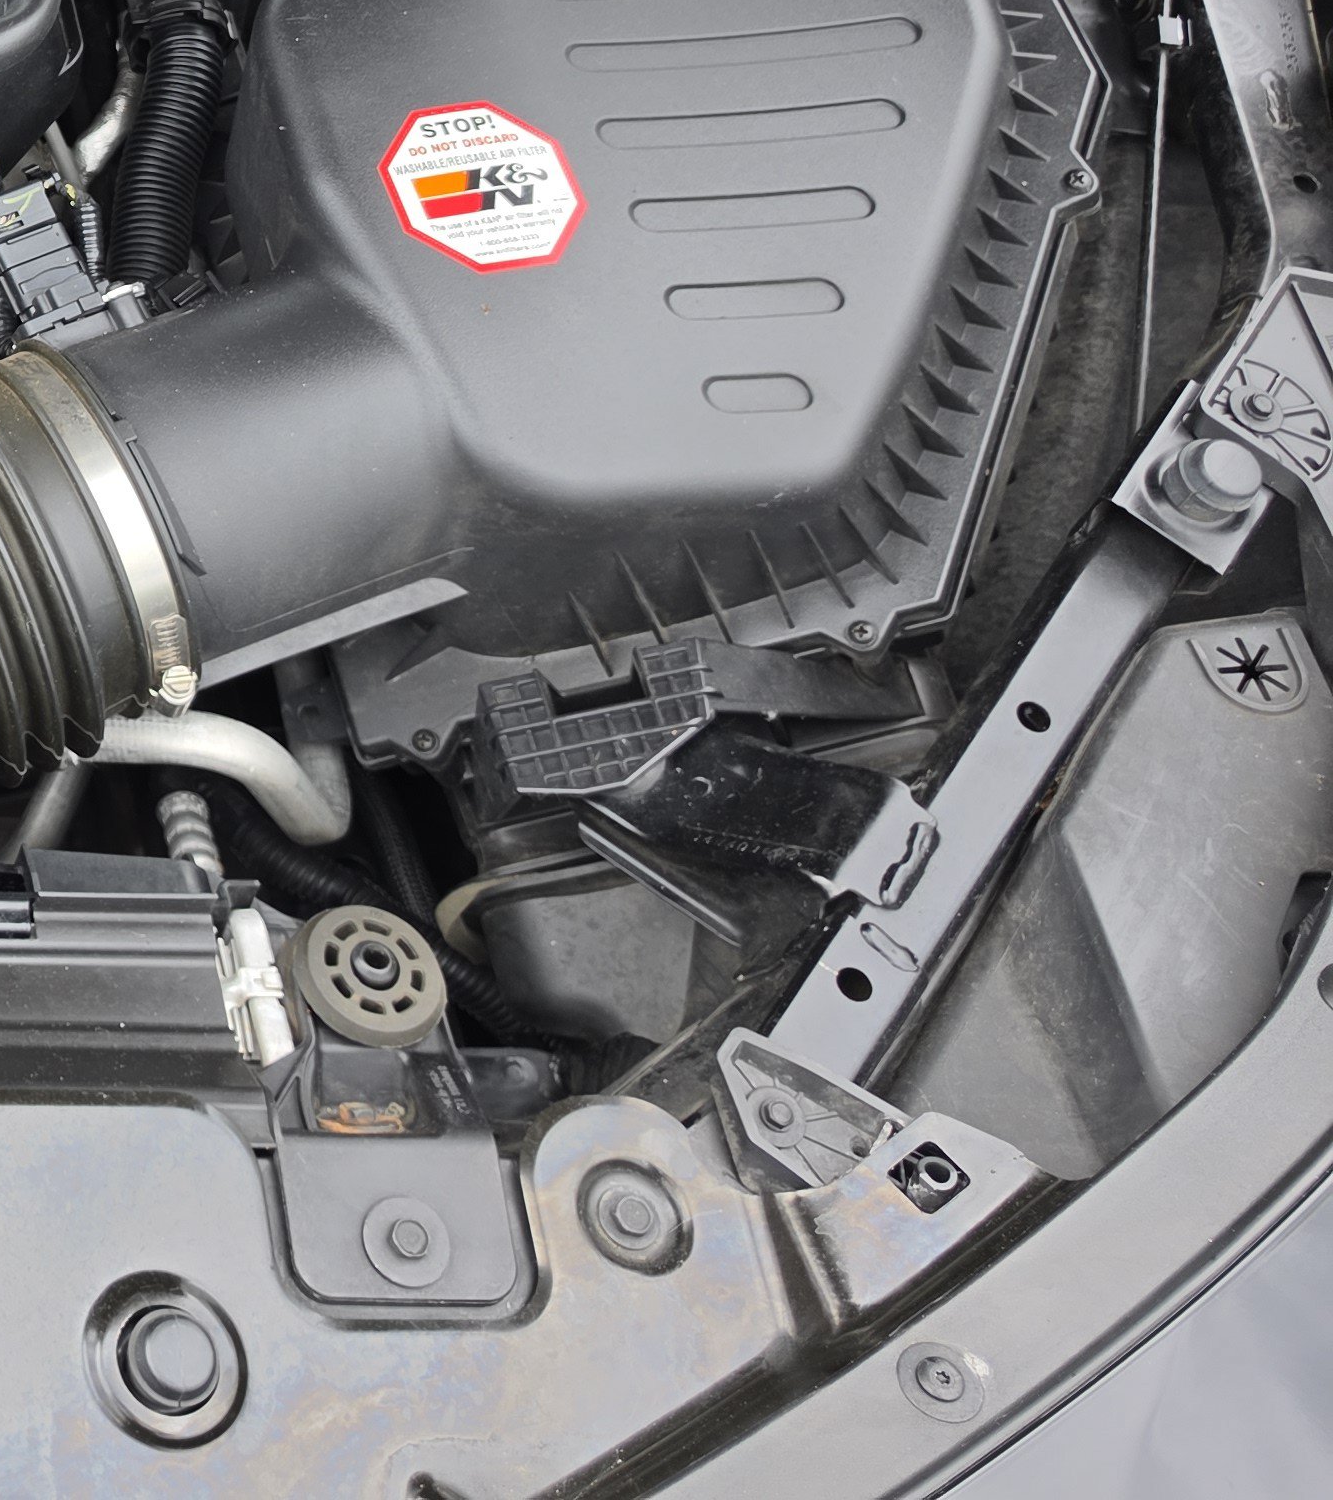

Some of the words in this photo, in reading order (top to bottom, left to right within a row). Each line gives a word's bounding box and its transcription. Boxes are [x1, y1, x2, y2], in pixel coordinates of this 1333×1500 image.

[421, 115, 496, 138] STOP!
[408, 144, 427, 157] DO
[431, 141, 458, 154] NOT
[463, 133, 518, 147] DISCARD
[394, 152, 497, 175] WASHABLE/REUSABLE
[501, 149, 515, 159] AIR
[518, 145, 547, 156] FILTER
